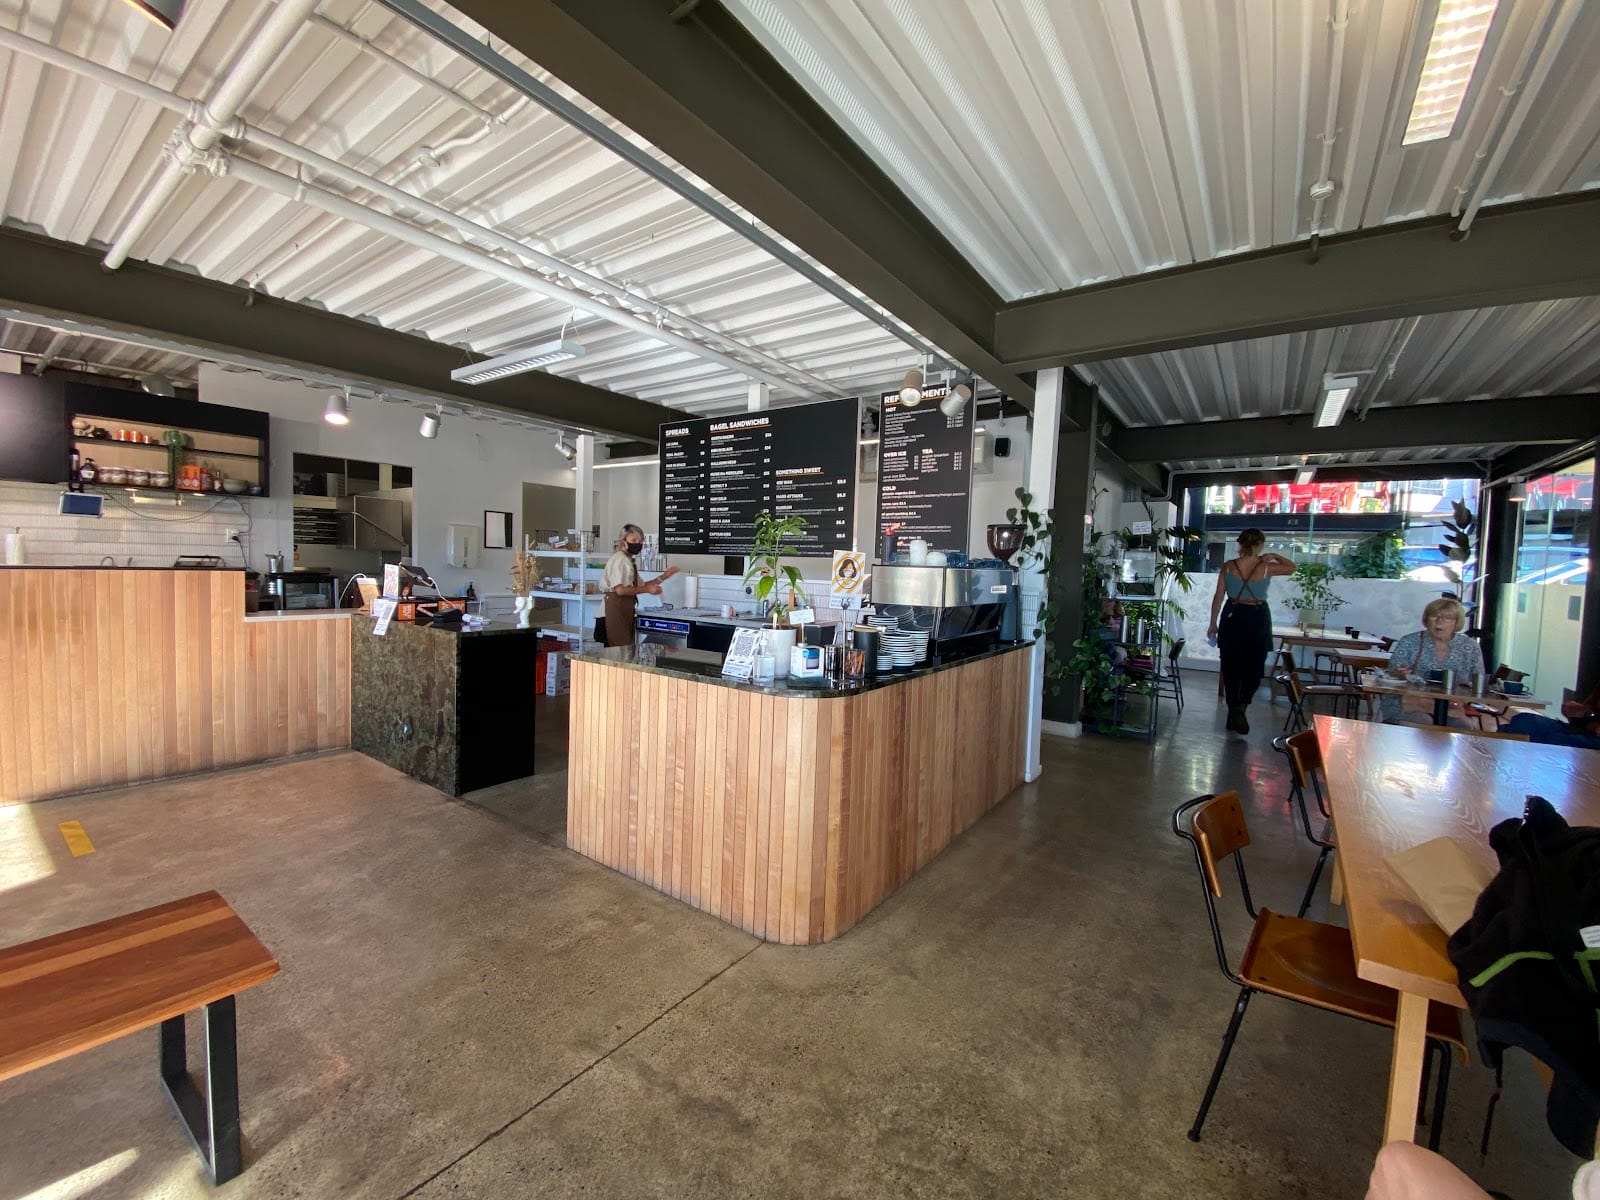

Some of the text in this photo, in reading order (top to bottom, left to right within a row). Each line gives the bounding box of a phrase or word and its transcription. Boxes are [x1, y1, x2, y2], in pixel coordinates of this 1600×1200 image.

[709, 417, 770, 431] BAGEL SANDWICHES
[665, 428, 689, 436] SPREADS
[775, 466, 822, 476] SOMETHING SWEET
